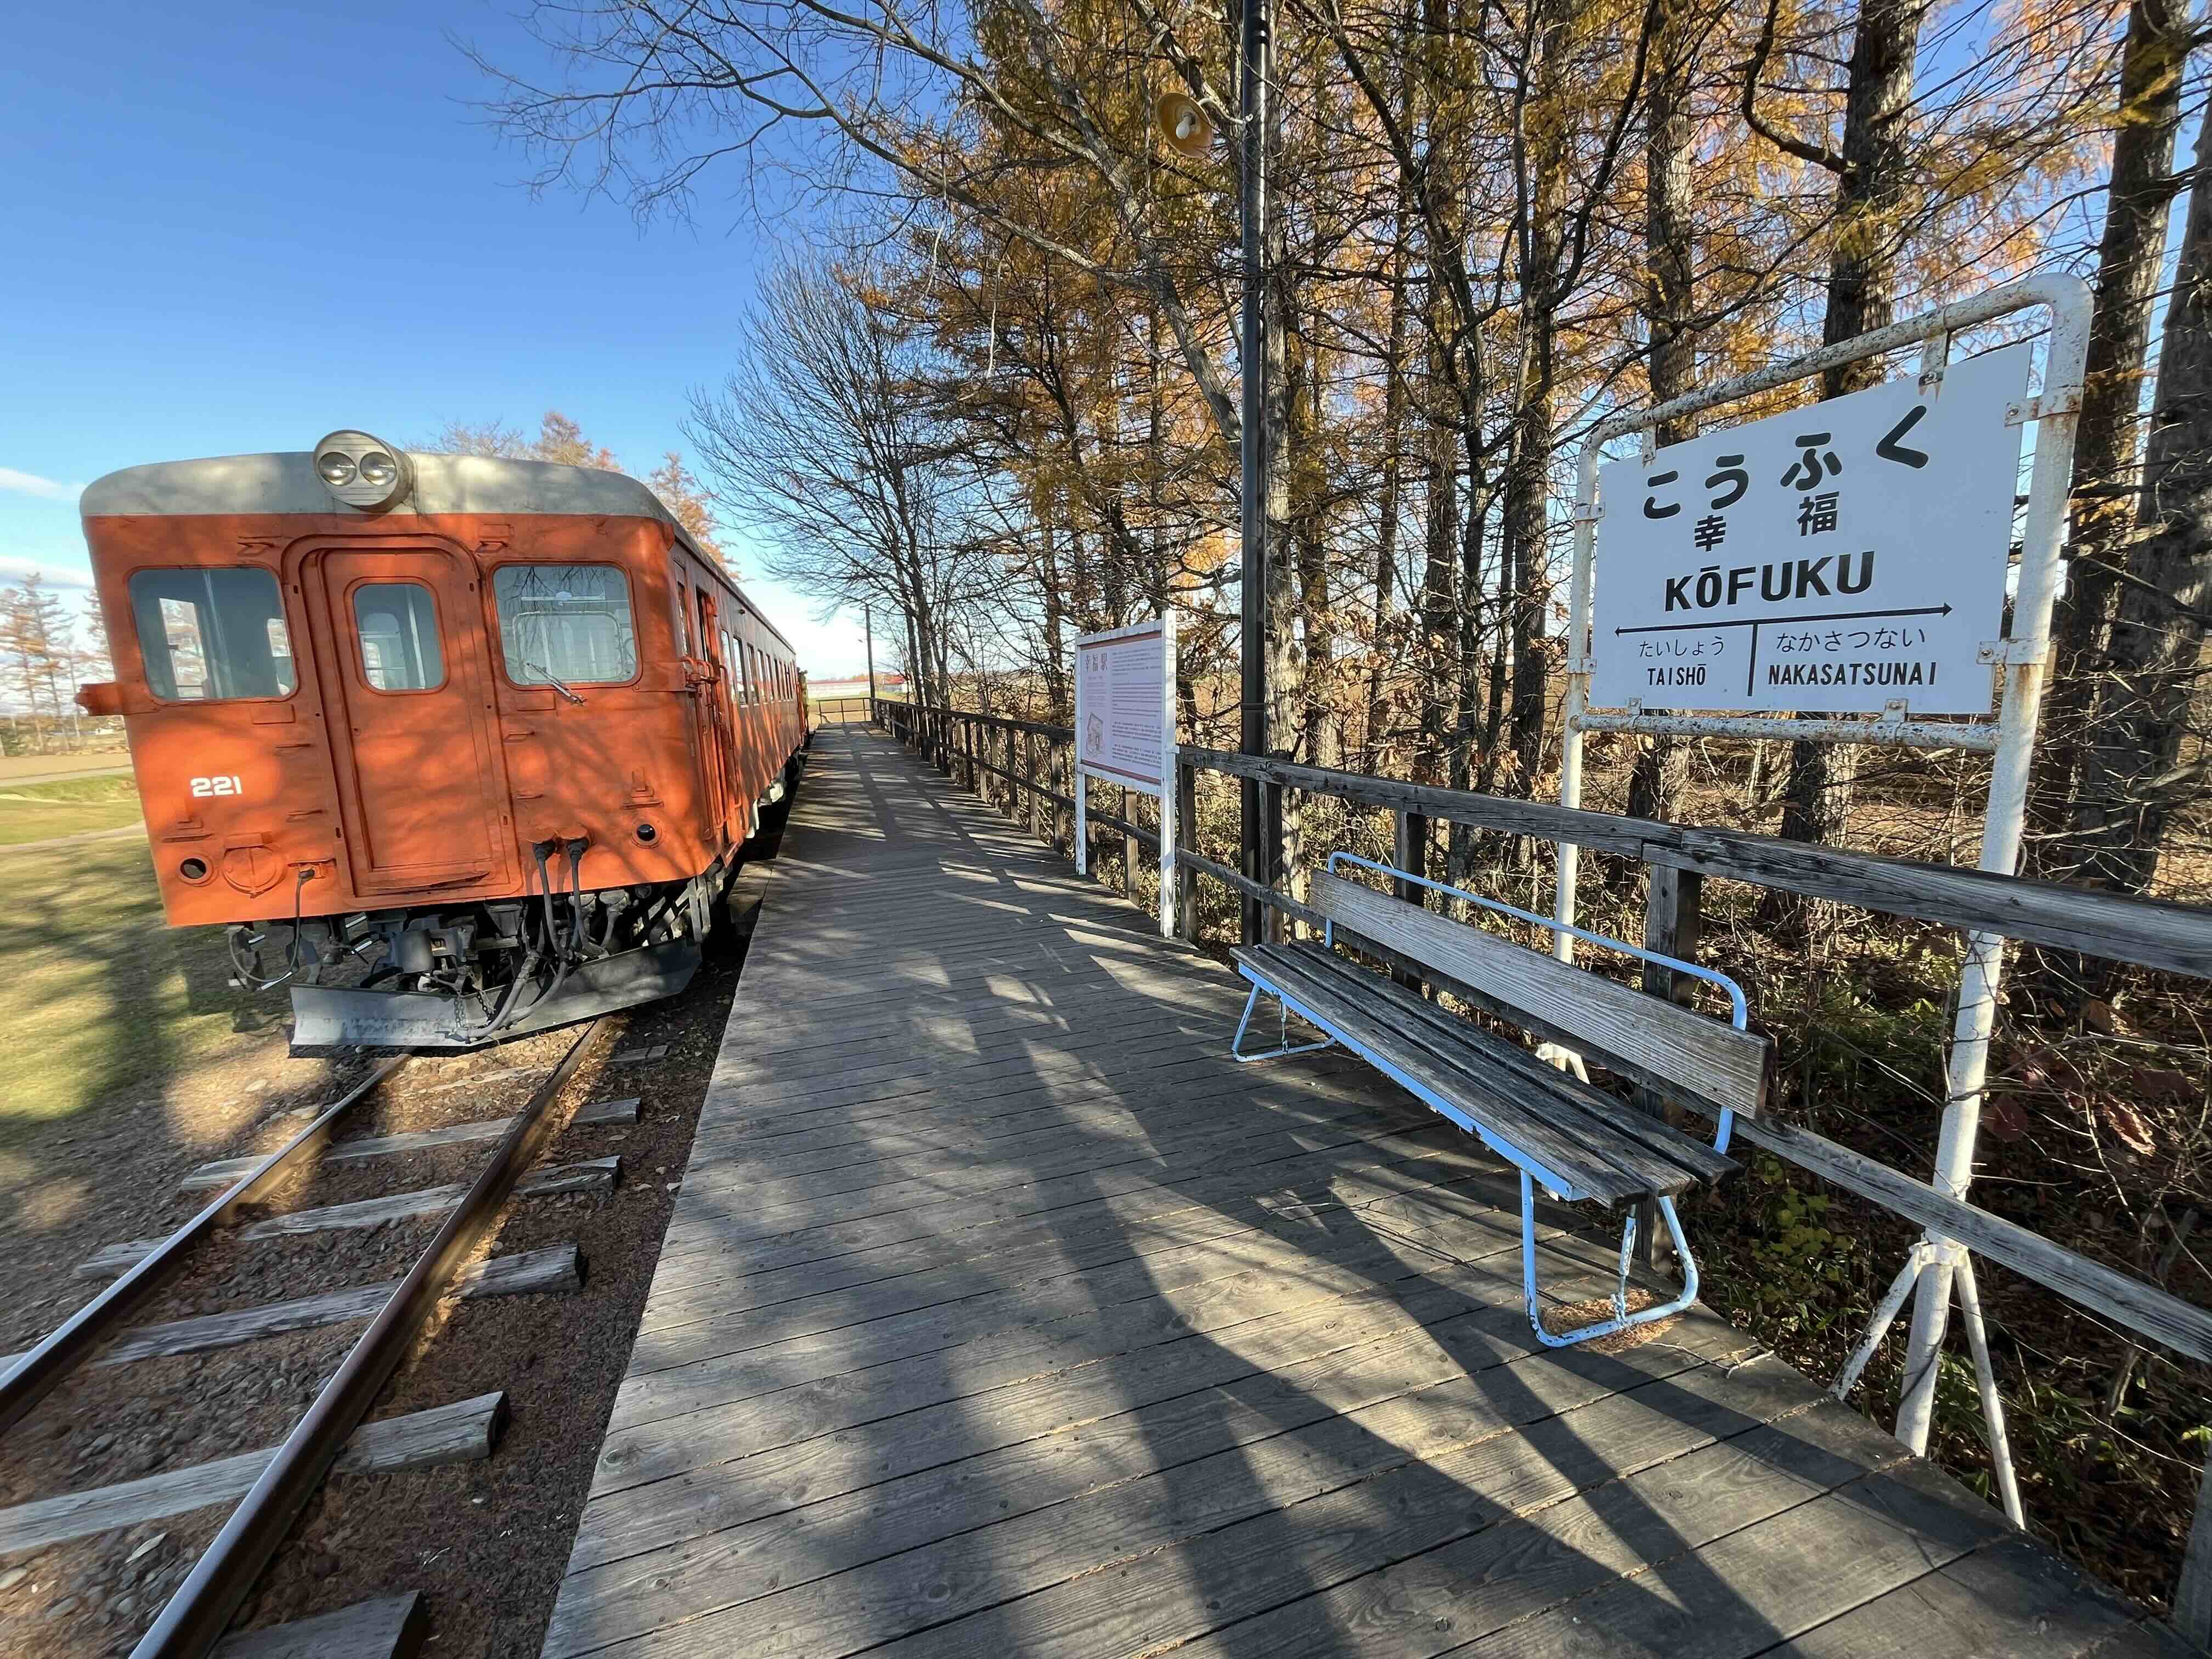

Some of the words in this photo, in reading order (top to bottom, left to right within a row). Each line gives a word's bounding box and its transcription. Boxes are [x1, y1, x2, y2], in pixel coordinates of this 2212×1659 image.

[1643, 405, 1929, 520] こうふく
[1694, 490, 1840, 552] 幸福
[1664, 550, 1875, 612] KŌFUKU
[1638, 635, 1724, 658] たいしょう
[1776, 627, 1926, 653] なかさつない
[1646, 663, 1707, 686] TAISHŌ
[1768, 661, 1937, 686] NAKASATSUNAI
[190, 776, 242, 797] 221
